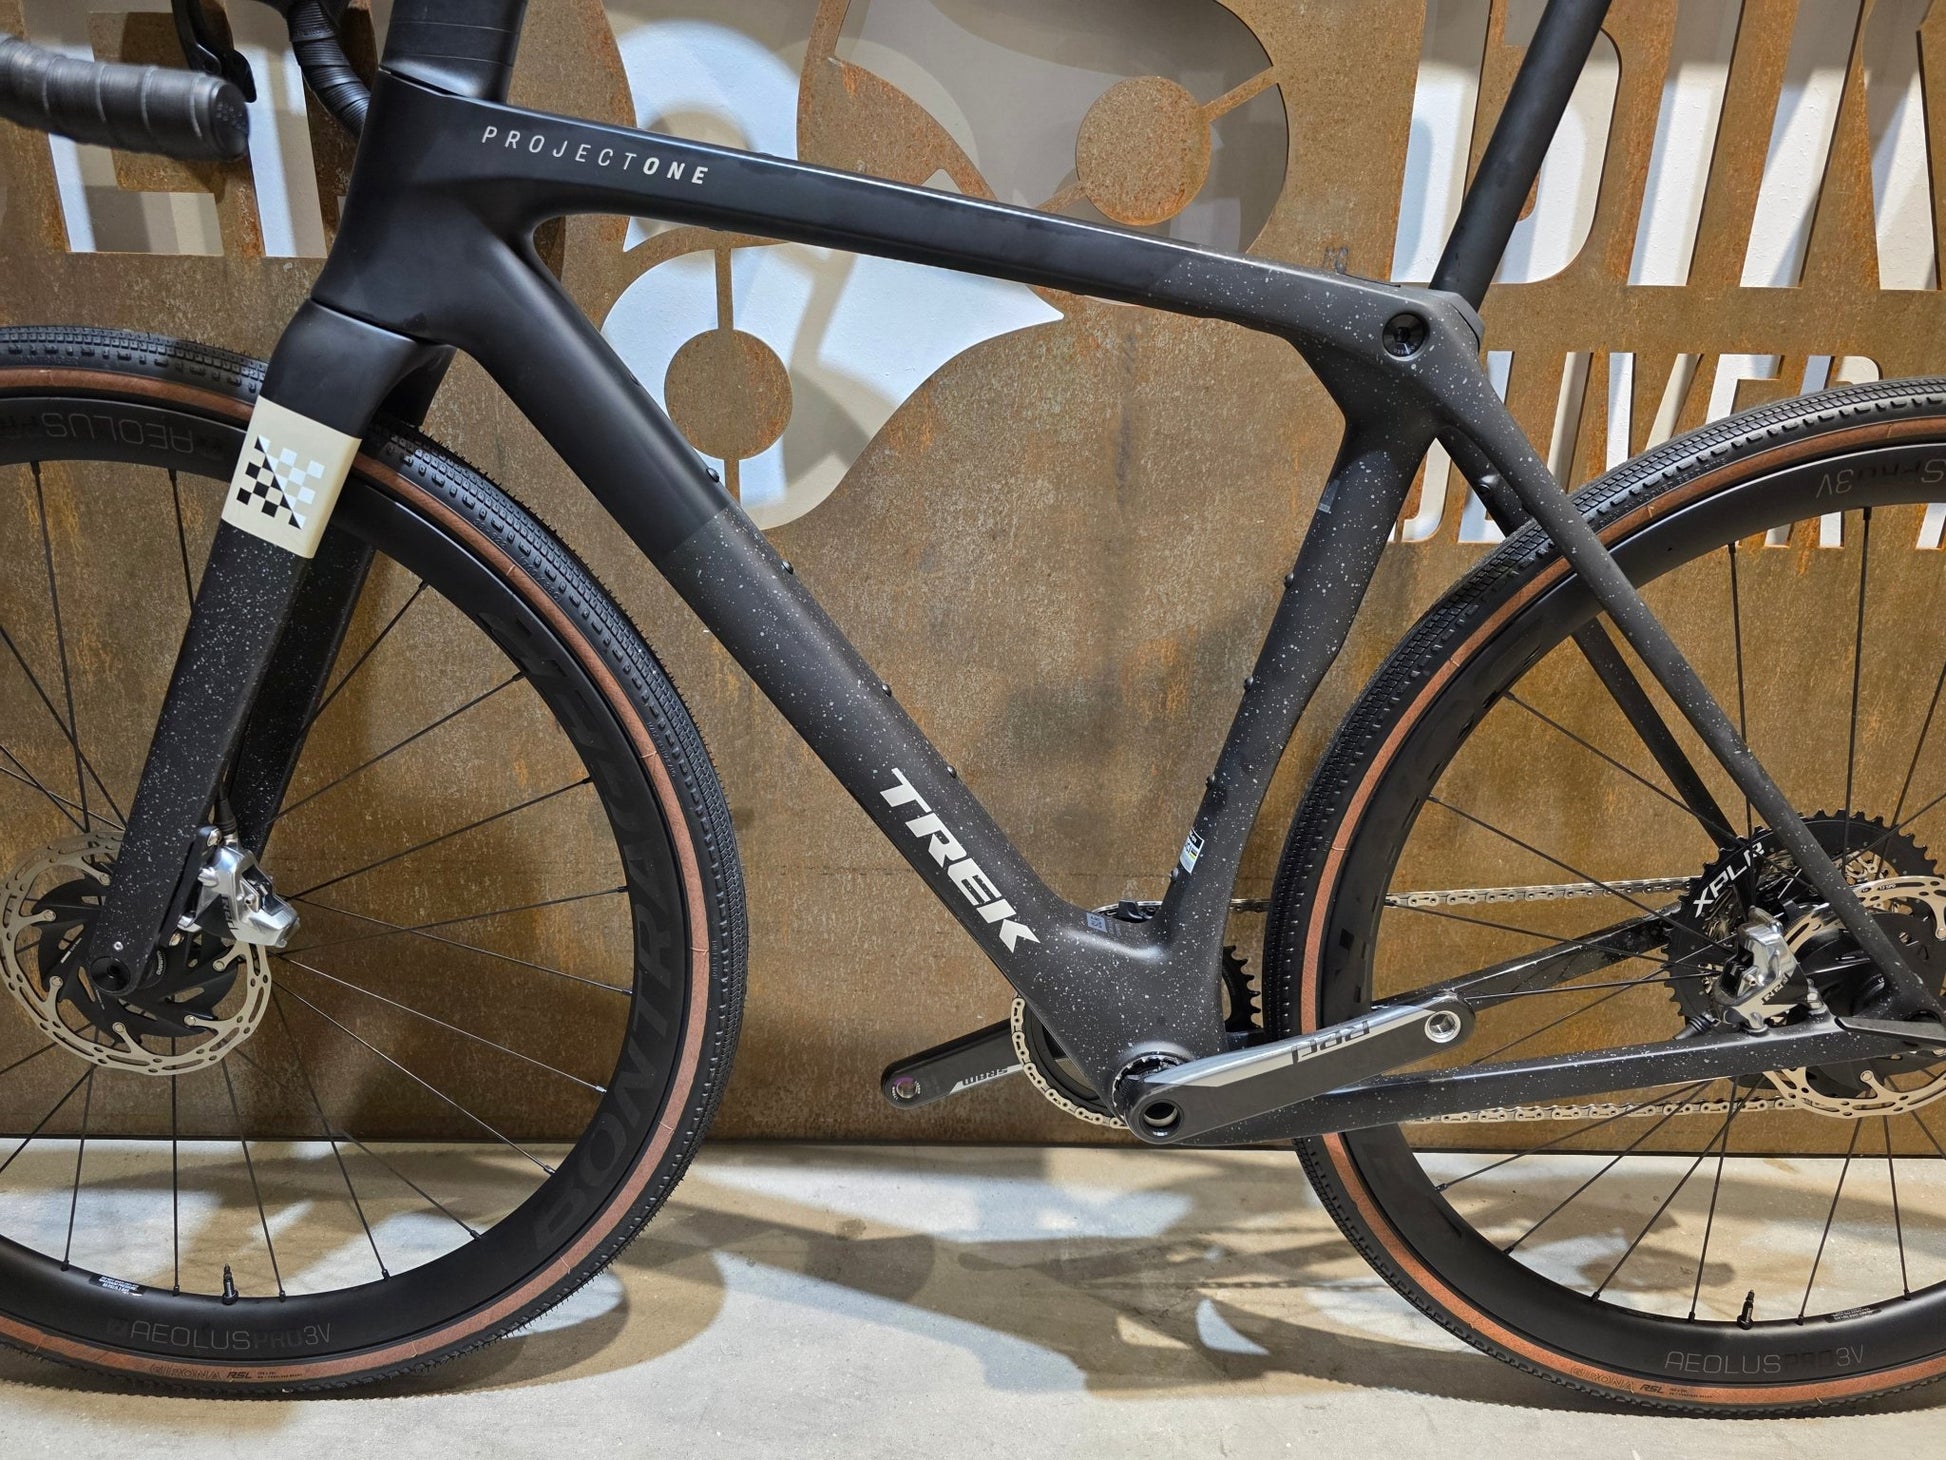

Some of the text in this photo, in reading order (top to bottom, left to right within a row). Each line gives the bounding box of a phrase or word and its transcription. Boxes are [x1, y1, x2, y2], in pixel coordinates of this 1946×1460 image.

[41, 412, 193, 453] AEOLUS
[880, 767, 1041, 953] TREK
[1692, 841, 1766, 919] XPLR
[130, 1320, 250, 1350] AEOLUS
[304, 1322, 331, 1345] 3V
[1664, 1349, 1782, 1374] AEOLUS
[1834, 1343, 1864, 1368] 3V
[226, 1371, 253, 1379] RSL
[1639, 1383, 1665, 1395] RSL
